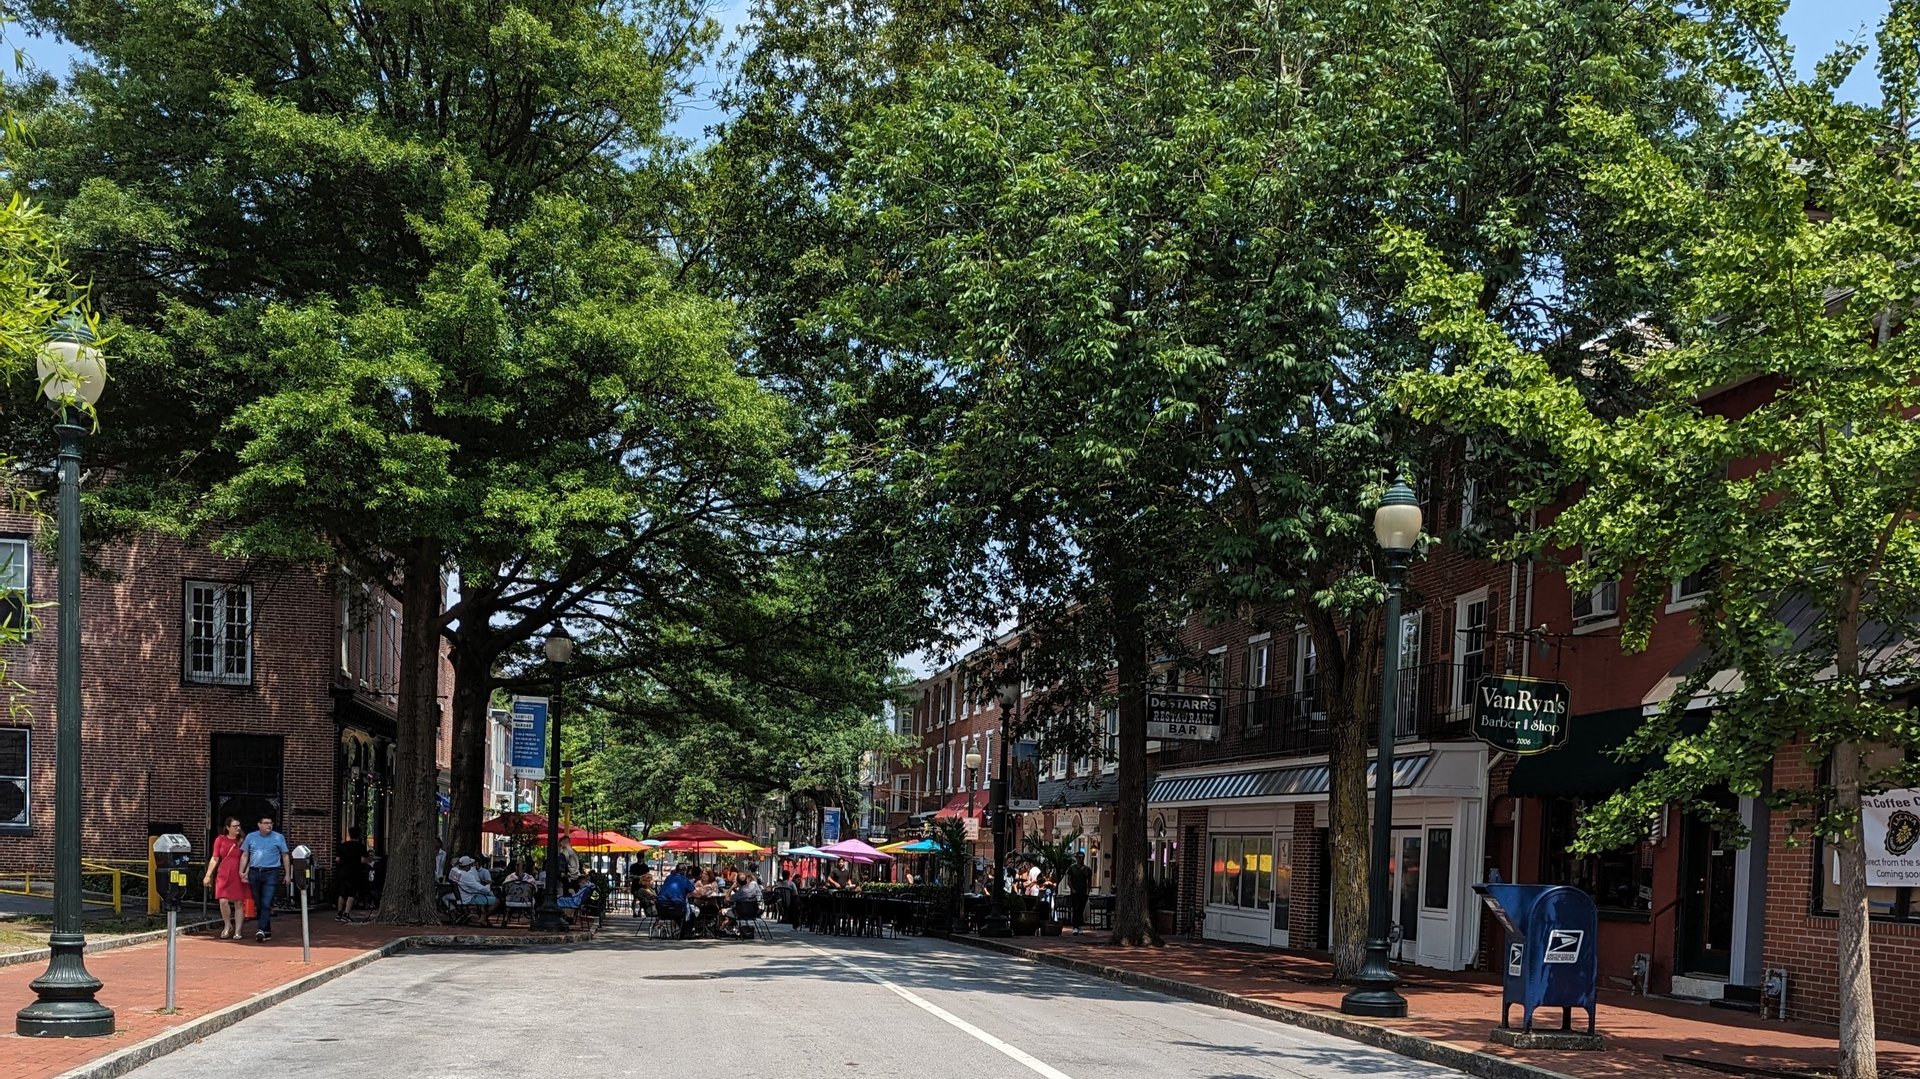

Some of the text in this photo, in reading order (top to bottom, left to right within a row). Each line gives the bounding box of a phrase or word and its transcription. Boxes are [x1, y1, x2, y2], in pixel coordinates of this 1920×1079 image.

[1481, 686, 1566, 717] VanRyn's
[1153, 710, 1214, 724] RESTAURANT
[1168, 724, 1197, 735] BAR
[1481, 715, 1560, 737] Barber Shop
[1516, 737, 1531, 745] 2006
[1873, 798, 1911, 809] Coffee
[1893, 814, 1917, 826] LACAVA
[1881, 858, 1899, 866] from
[1900, 858, 1914, 866] the
[1876, 869, 1903, 880] Coming
